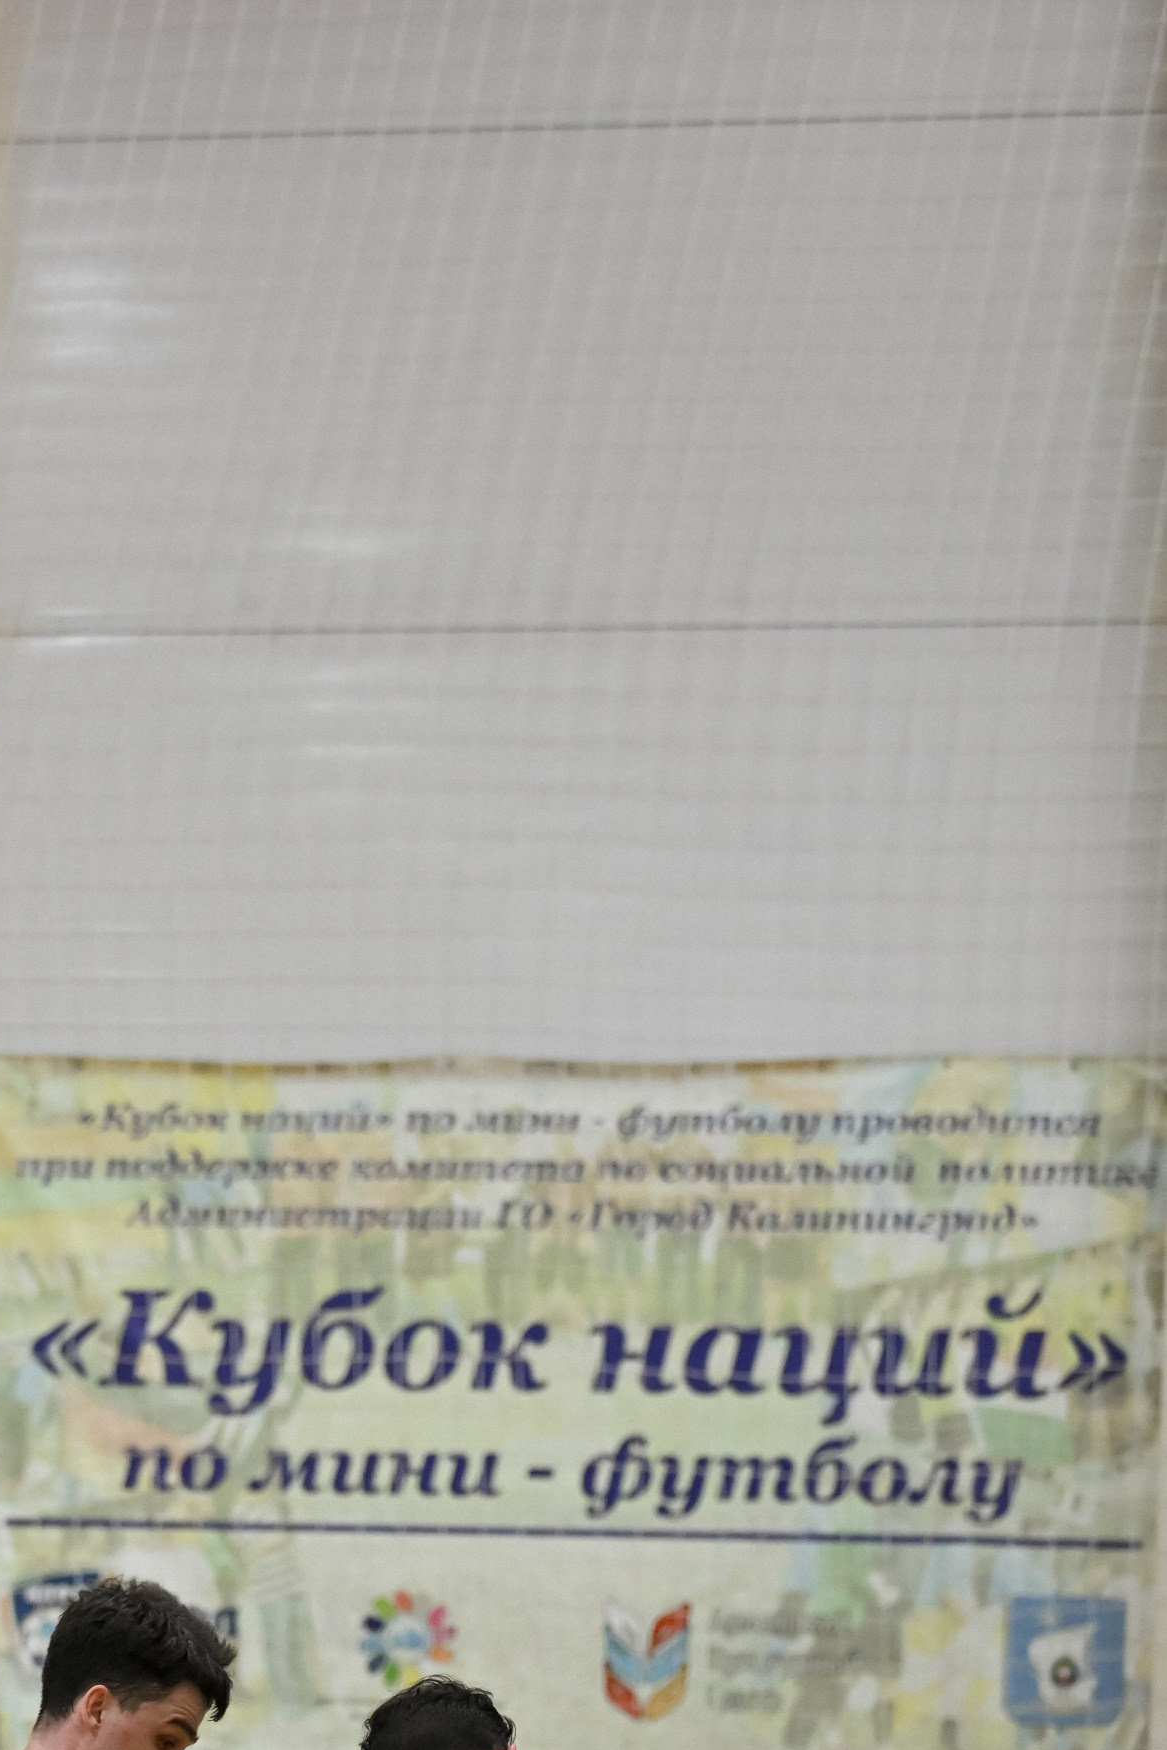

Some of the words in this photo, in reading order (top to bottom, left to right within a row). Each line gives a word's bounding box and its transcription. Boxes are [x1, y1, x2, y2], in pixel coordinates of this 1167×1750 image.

[80, 1102, 228, 1140] «Кубок
[405, 1110, 456, 1132] по
[465, 1110, 581, 1133] мини
[617, 1105, 821, 1142] футболу
[833, 1105, 1102, 1144] проводится
[17, 1157, 94, 1186] при
[105, 1149, 338, 1188] поддержке
[351, 1158, 584, 1183] комитета
[598, 1159, 647, 1182] по
[658, 1156, 916, 1190] социальной
[126, 1199, 481, 1232] Администрации
[497, 1200, 554, 1230] ГО
[33, 1286, 553, 1416] «Кубок
[590, 1290, 1128, 1425] наций»
[122, 1446, 227, 1491] по
[244, 1449, 500, 1497] мини
[581, 1435, 1024, 1523] футболу
